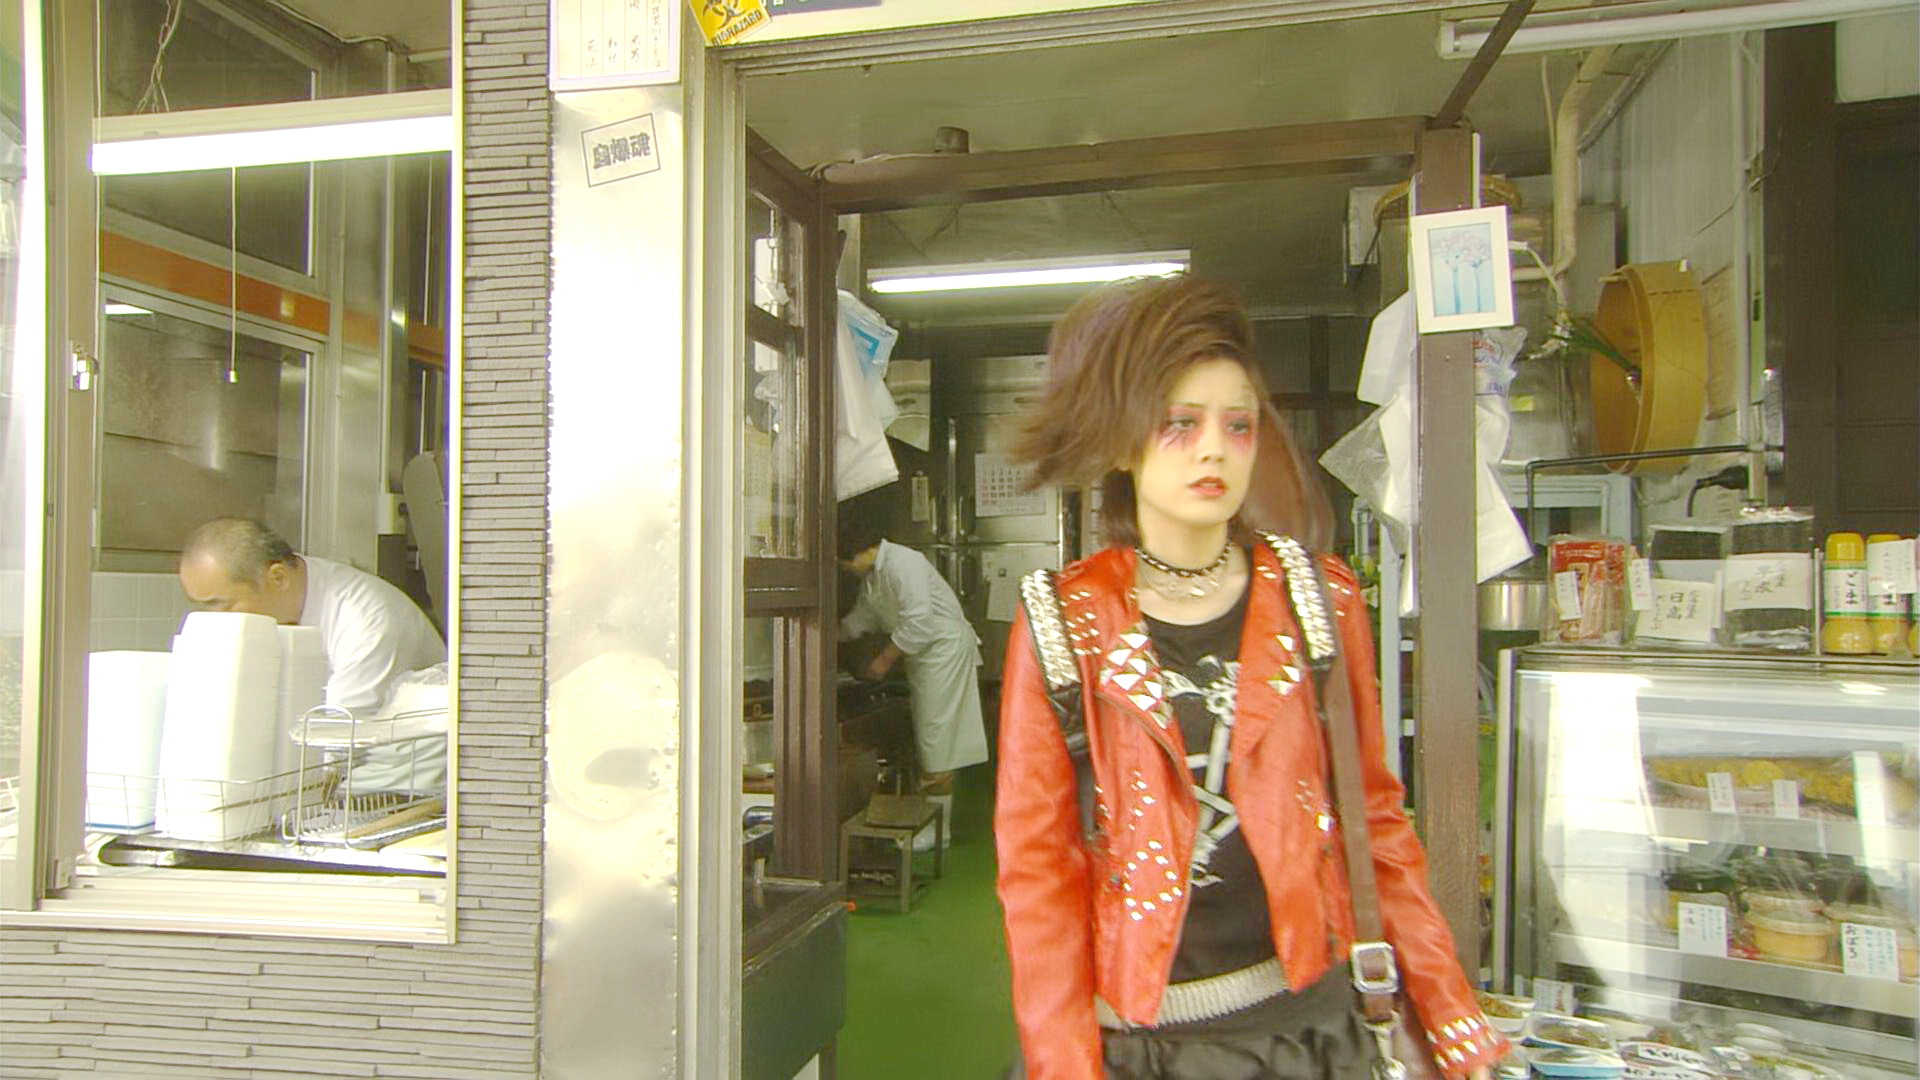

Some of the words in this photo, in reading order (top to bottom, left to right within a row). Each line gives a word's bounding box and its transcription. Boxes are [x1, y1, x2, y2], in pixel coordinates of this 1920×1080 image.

[711, 9, 763, 47] BIOHAZARD
[593, 132, 651, 169] 自爆魂
